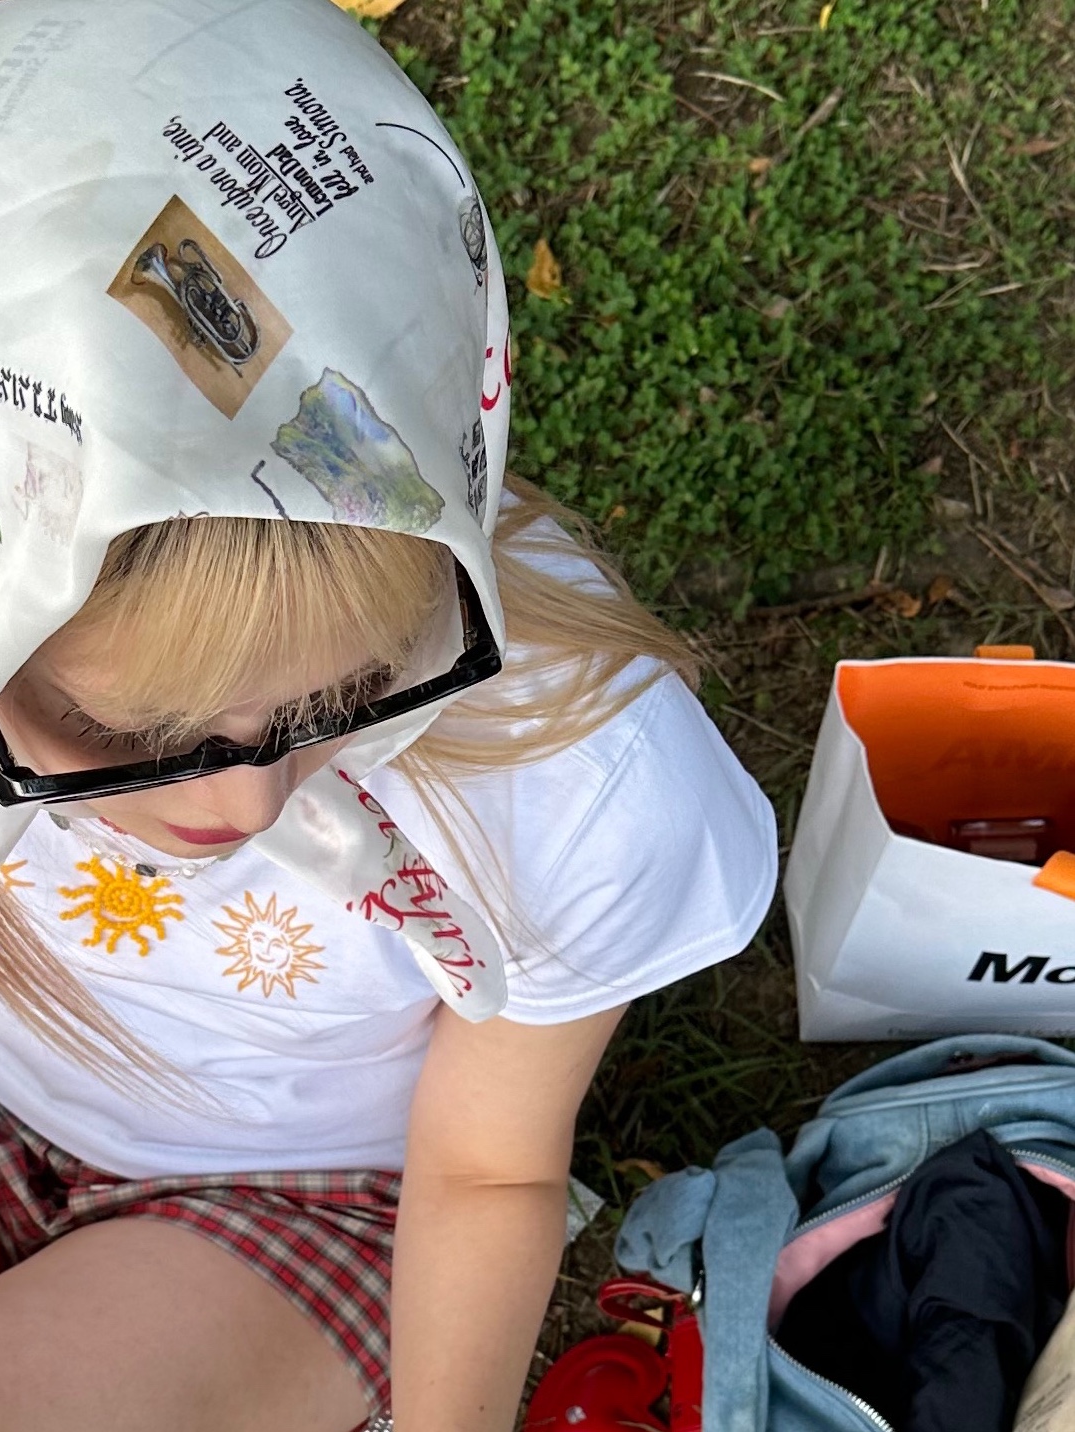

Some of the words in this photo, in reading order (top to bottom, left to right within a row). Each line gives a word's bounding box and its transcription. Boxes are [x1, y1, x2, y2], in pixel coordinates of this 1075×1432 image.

[284, 77, 347, 149] Simona.
[162, 115, 205, 162] time,
[201, 121, 242, 153] and
[284, 115, 320, 151] love
[196, 154, 217, 171] a
[235, 147, 277, 195] Mom
[313, 149, 332, 170] in
[339, 145, 361, 168] had
[352, 163, 375, 185] and
[210, 167, 257, 210] upon
[320, 169, 359, 200] fell
[262, 183, 314, 234] Angel
[245, 206, 287, 259] Once
